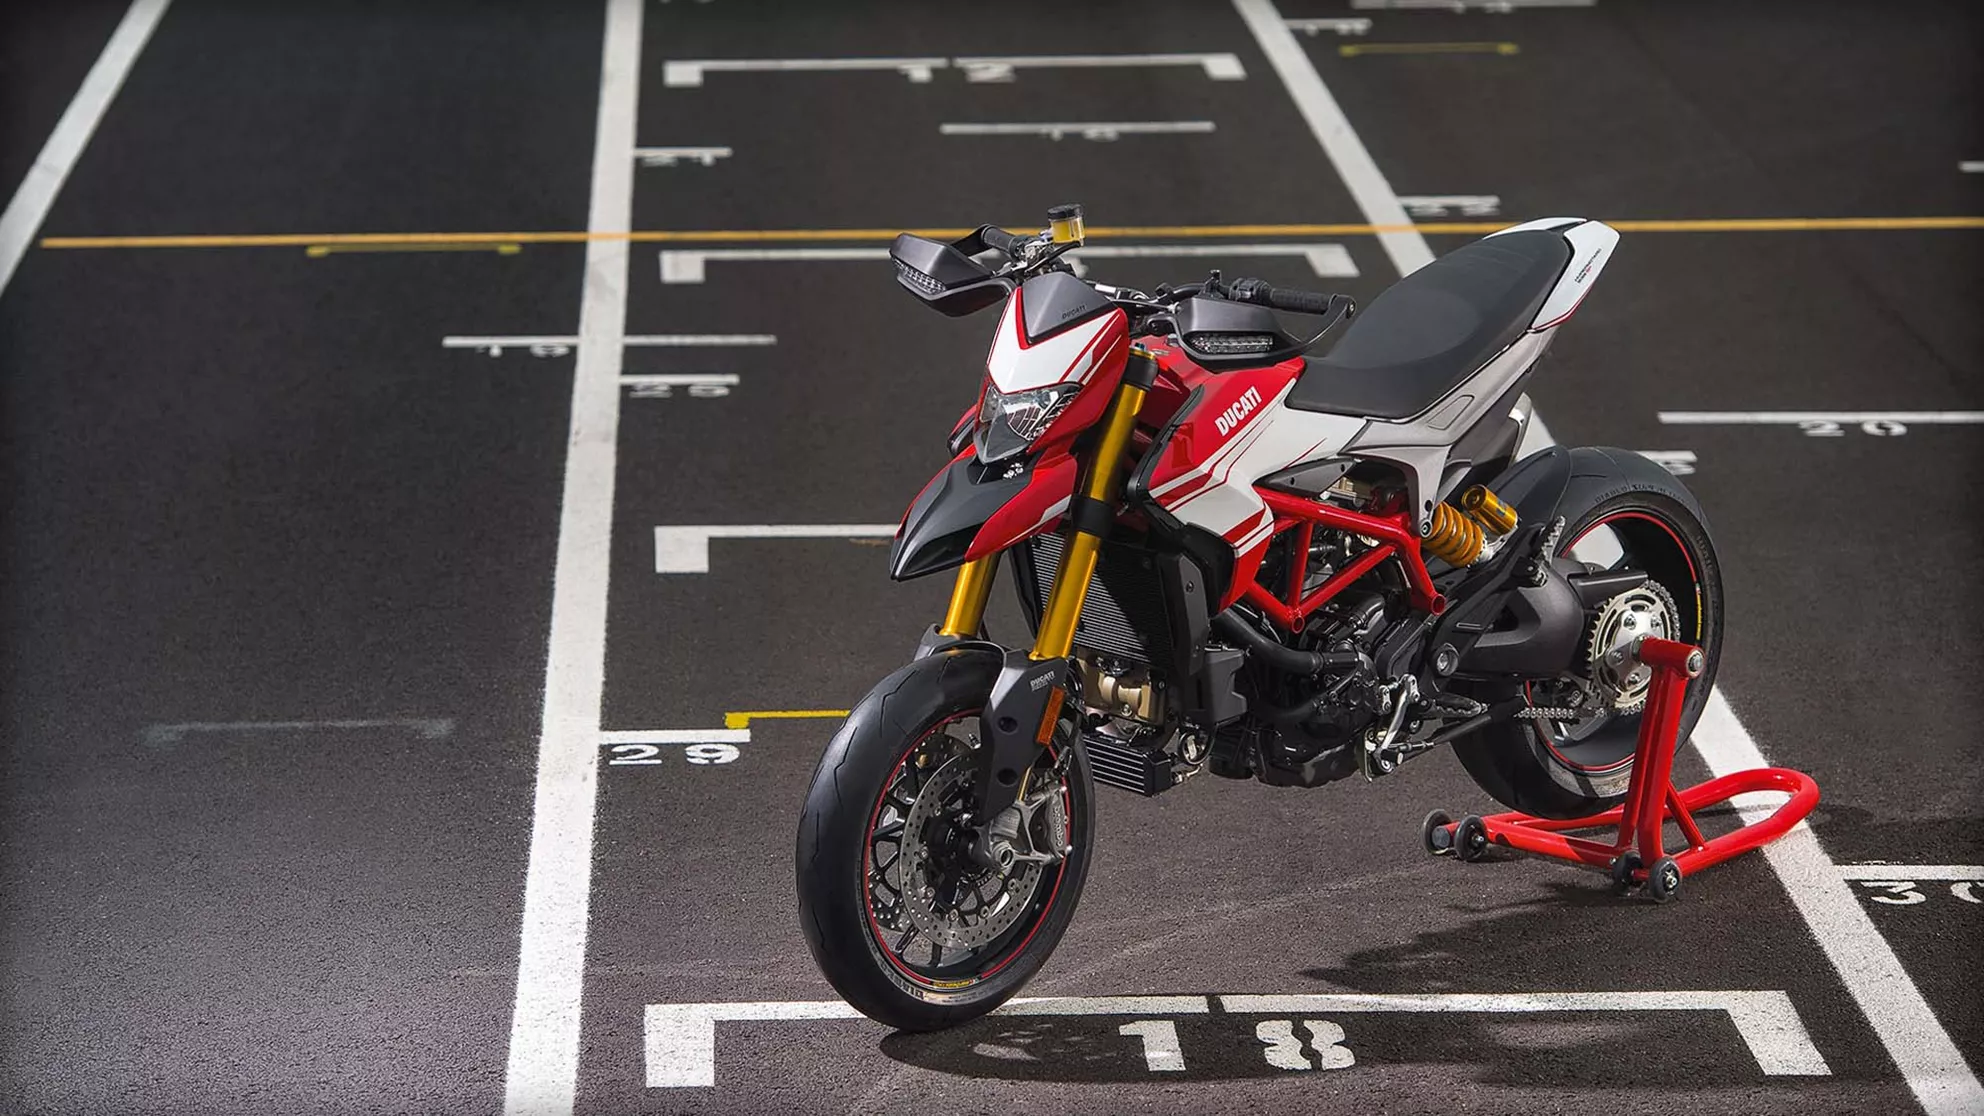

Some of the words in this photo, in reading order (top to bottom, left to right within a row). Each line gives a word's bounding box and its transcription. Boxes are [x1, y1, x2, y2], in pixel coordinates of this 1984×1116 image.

[1214, 385, 1263, 437] DUCATI
[1030, 670, 1055, 687] DUCATI
[608, 743, 741, 766] 29
[1118, 1019, 1356, 1072] 18
